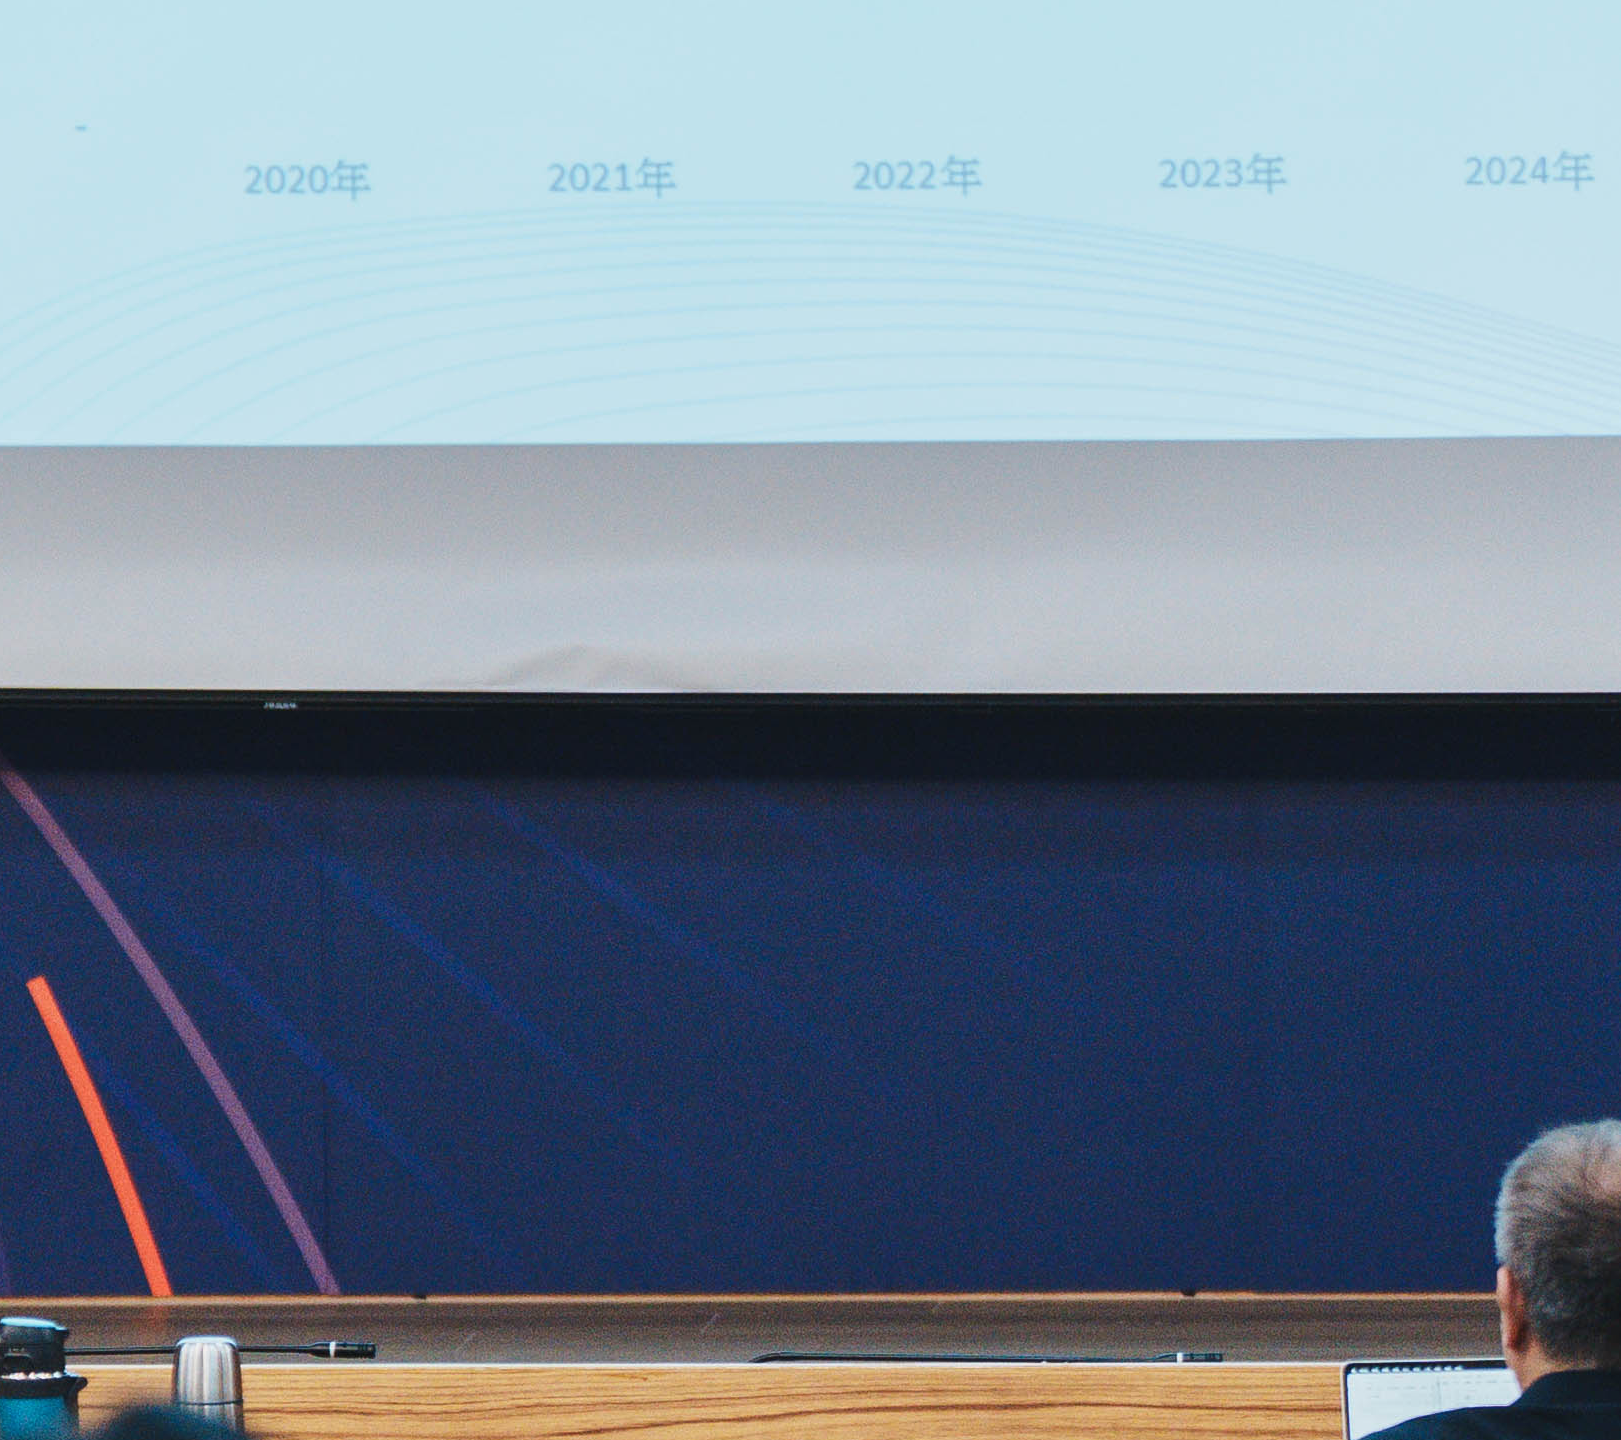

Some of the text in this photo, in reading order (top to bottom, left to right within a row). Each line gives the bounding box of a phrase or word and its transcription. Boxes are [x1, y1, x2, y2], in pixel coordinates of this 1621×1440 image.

[245, 160, 371, 200] 2020年
[550, 158, 676, 197] 2021年
[854, 155, 982, 195] 2022年
[1160, 153, 1287, 194] 2023年
[1466, 151, 1594, 190] 2024年
